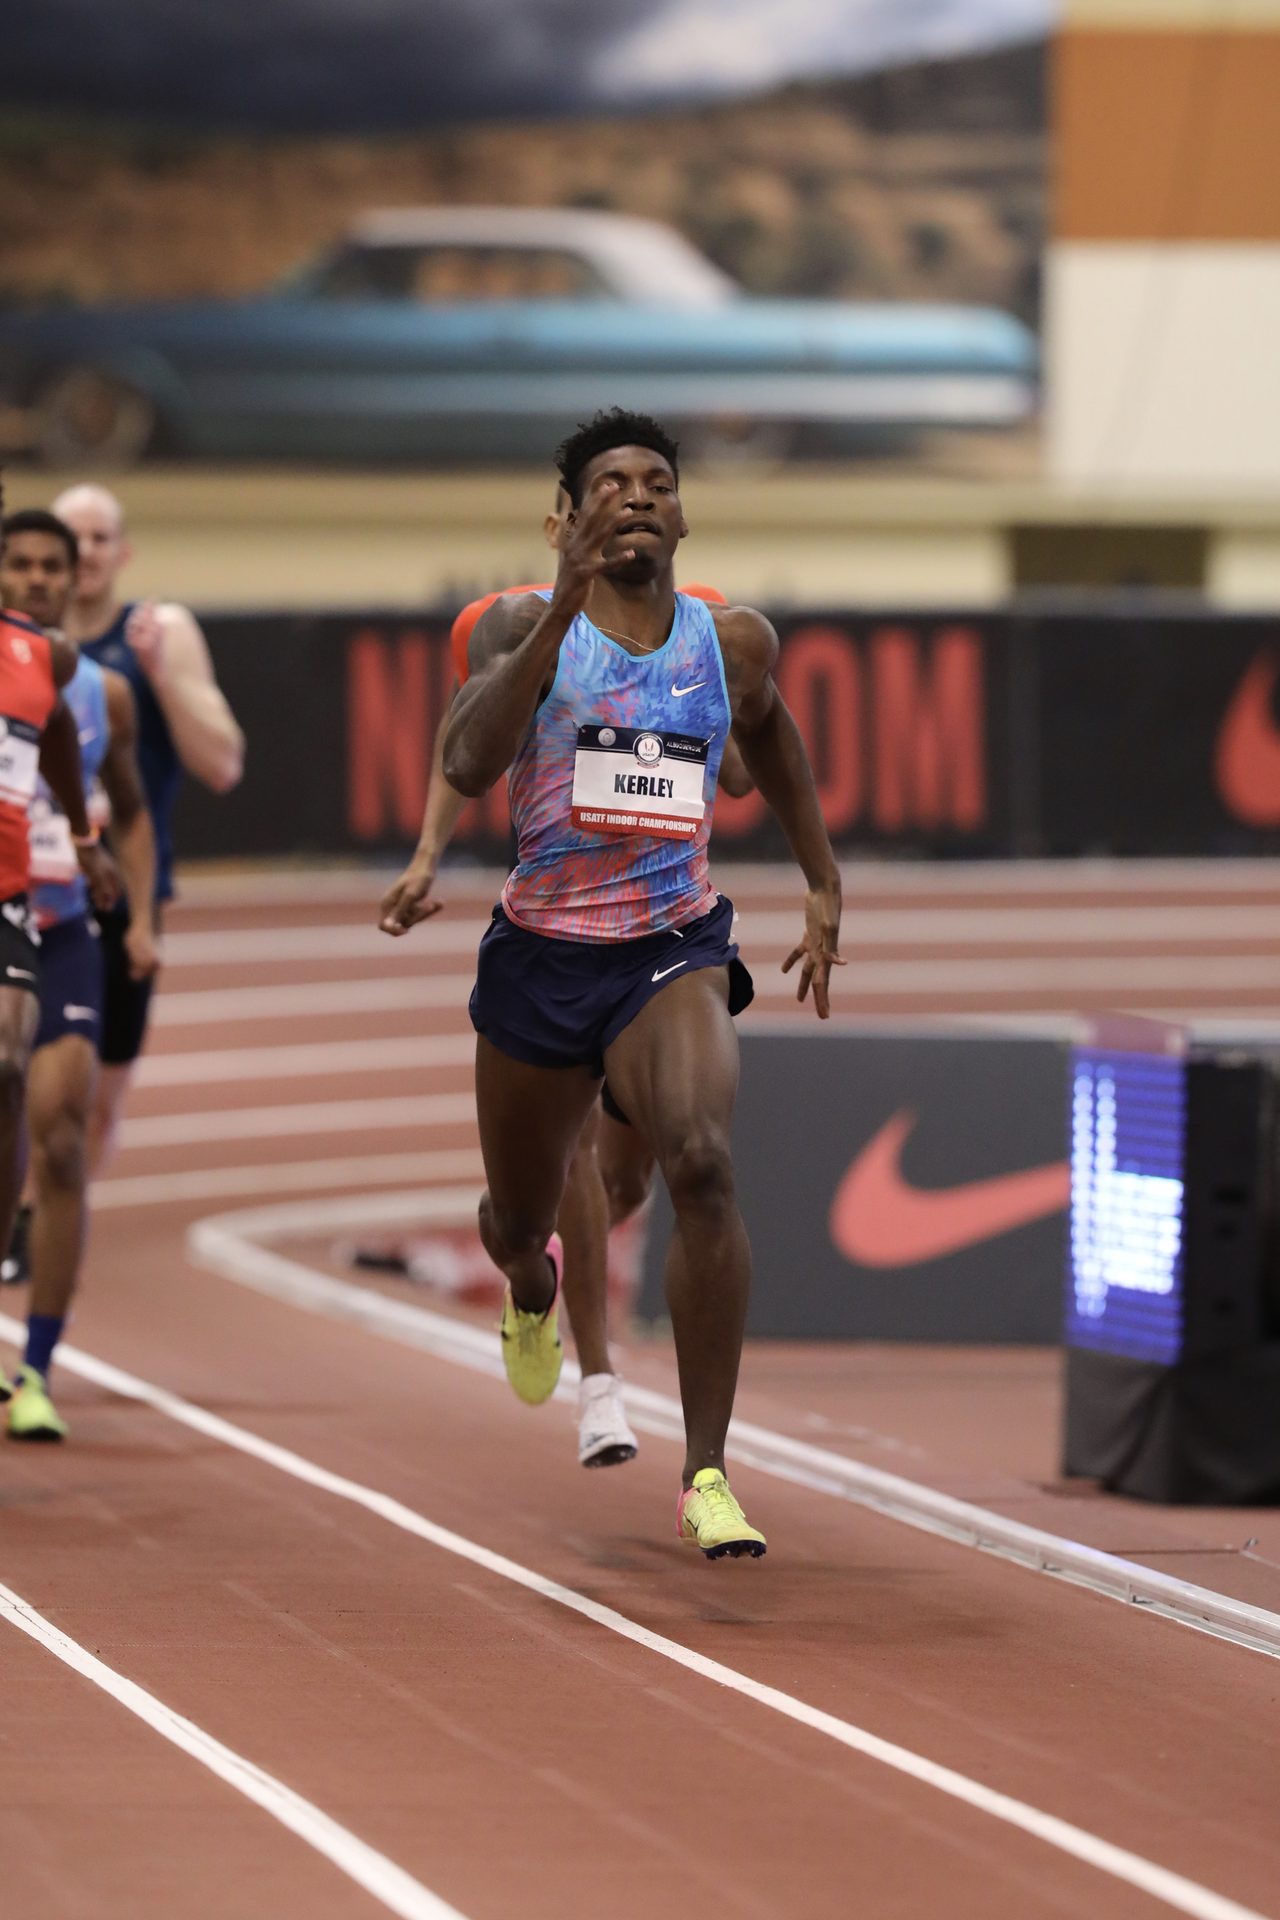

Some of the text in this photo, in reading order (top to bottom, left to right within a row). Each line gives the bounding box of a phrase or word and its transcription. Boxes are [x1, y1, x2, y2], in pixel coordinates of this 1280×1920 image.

[614, 773, 674, 798] KERLEY
[580, 812, 697, 833] USATF INDOOR CHAMPIONSHIPS
